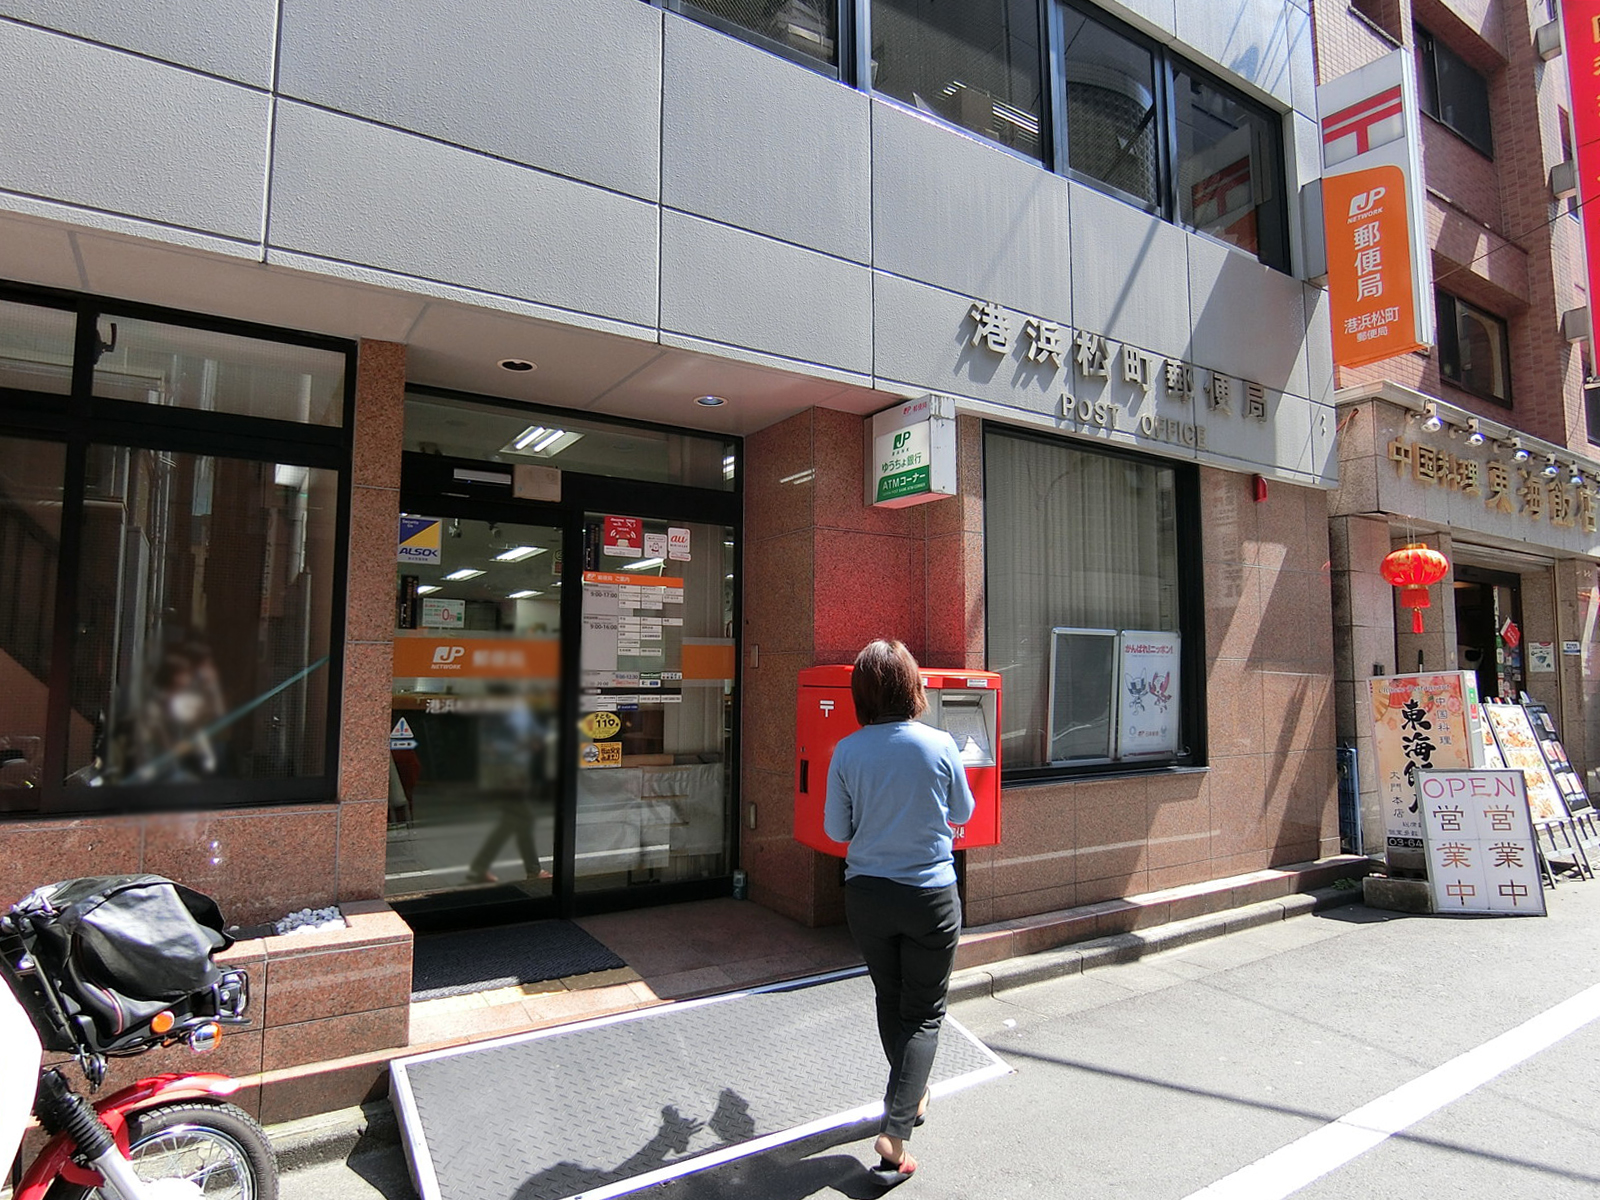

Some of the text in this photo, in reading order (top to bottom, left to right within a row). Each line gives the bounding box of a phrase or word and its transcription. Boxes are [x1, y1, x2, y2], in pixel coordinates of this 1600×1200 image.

[1347, 206, 1384, 224] NETWORK
[1354, 221, 1383, 302] 郵便局
[1344, 306, 1399, 335] 港浜松町
[1356, 326, 1388, 343] 郵便局
[970, 300, 1269, 424] 港浜松町郵便局
[1060, 392, 1208, 450] POST OFFICE
[881, 452, 922, 474] ゆうちょ銀行
[882, 472, 926, 491] ATMコーナー
[1388, 435, 1481, 498] 中国料理
[399, 547, 438, 558] ALSOK
[671, 535, 688, 544] au
[1435, 697, 1452, 746] 中国料理
[1389, 771, 1405, 819] 大門本店
[1423, 776, 1516, 799] OPEN
[1432, 804, 1476, 907] 営業中
[1483, 804, 1529, 907] 営業中
